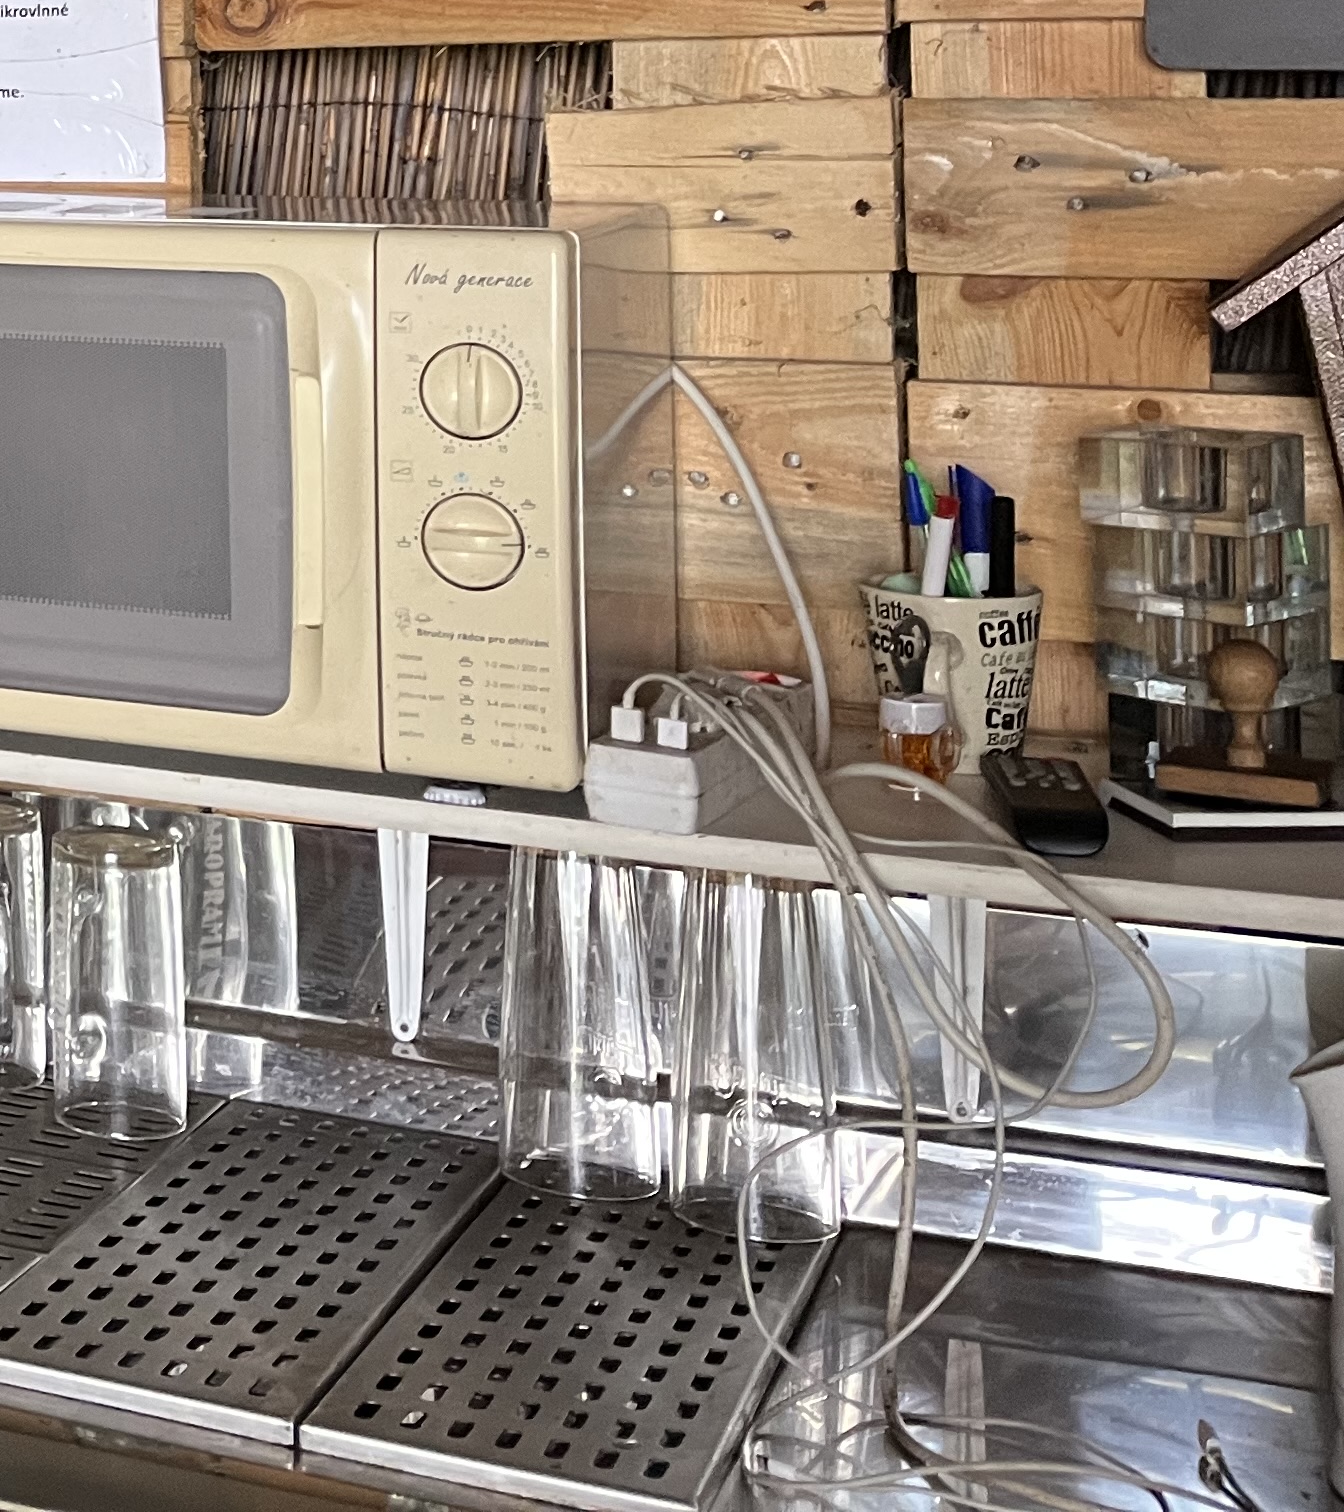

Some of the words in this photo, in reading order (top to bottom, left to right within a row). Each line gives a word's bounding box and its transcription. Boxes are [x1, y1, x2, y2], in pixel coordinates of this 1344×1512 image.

[405, 263, 450, 285] Nová
[453, 273, 534, 294] generace
[985, 671, 1032, 700] latte
